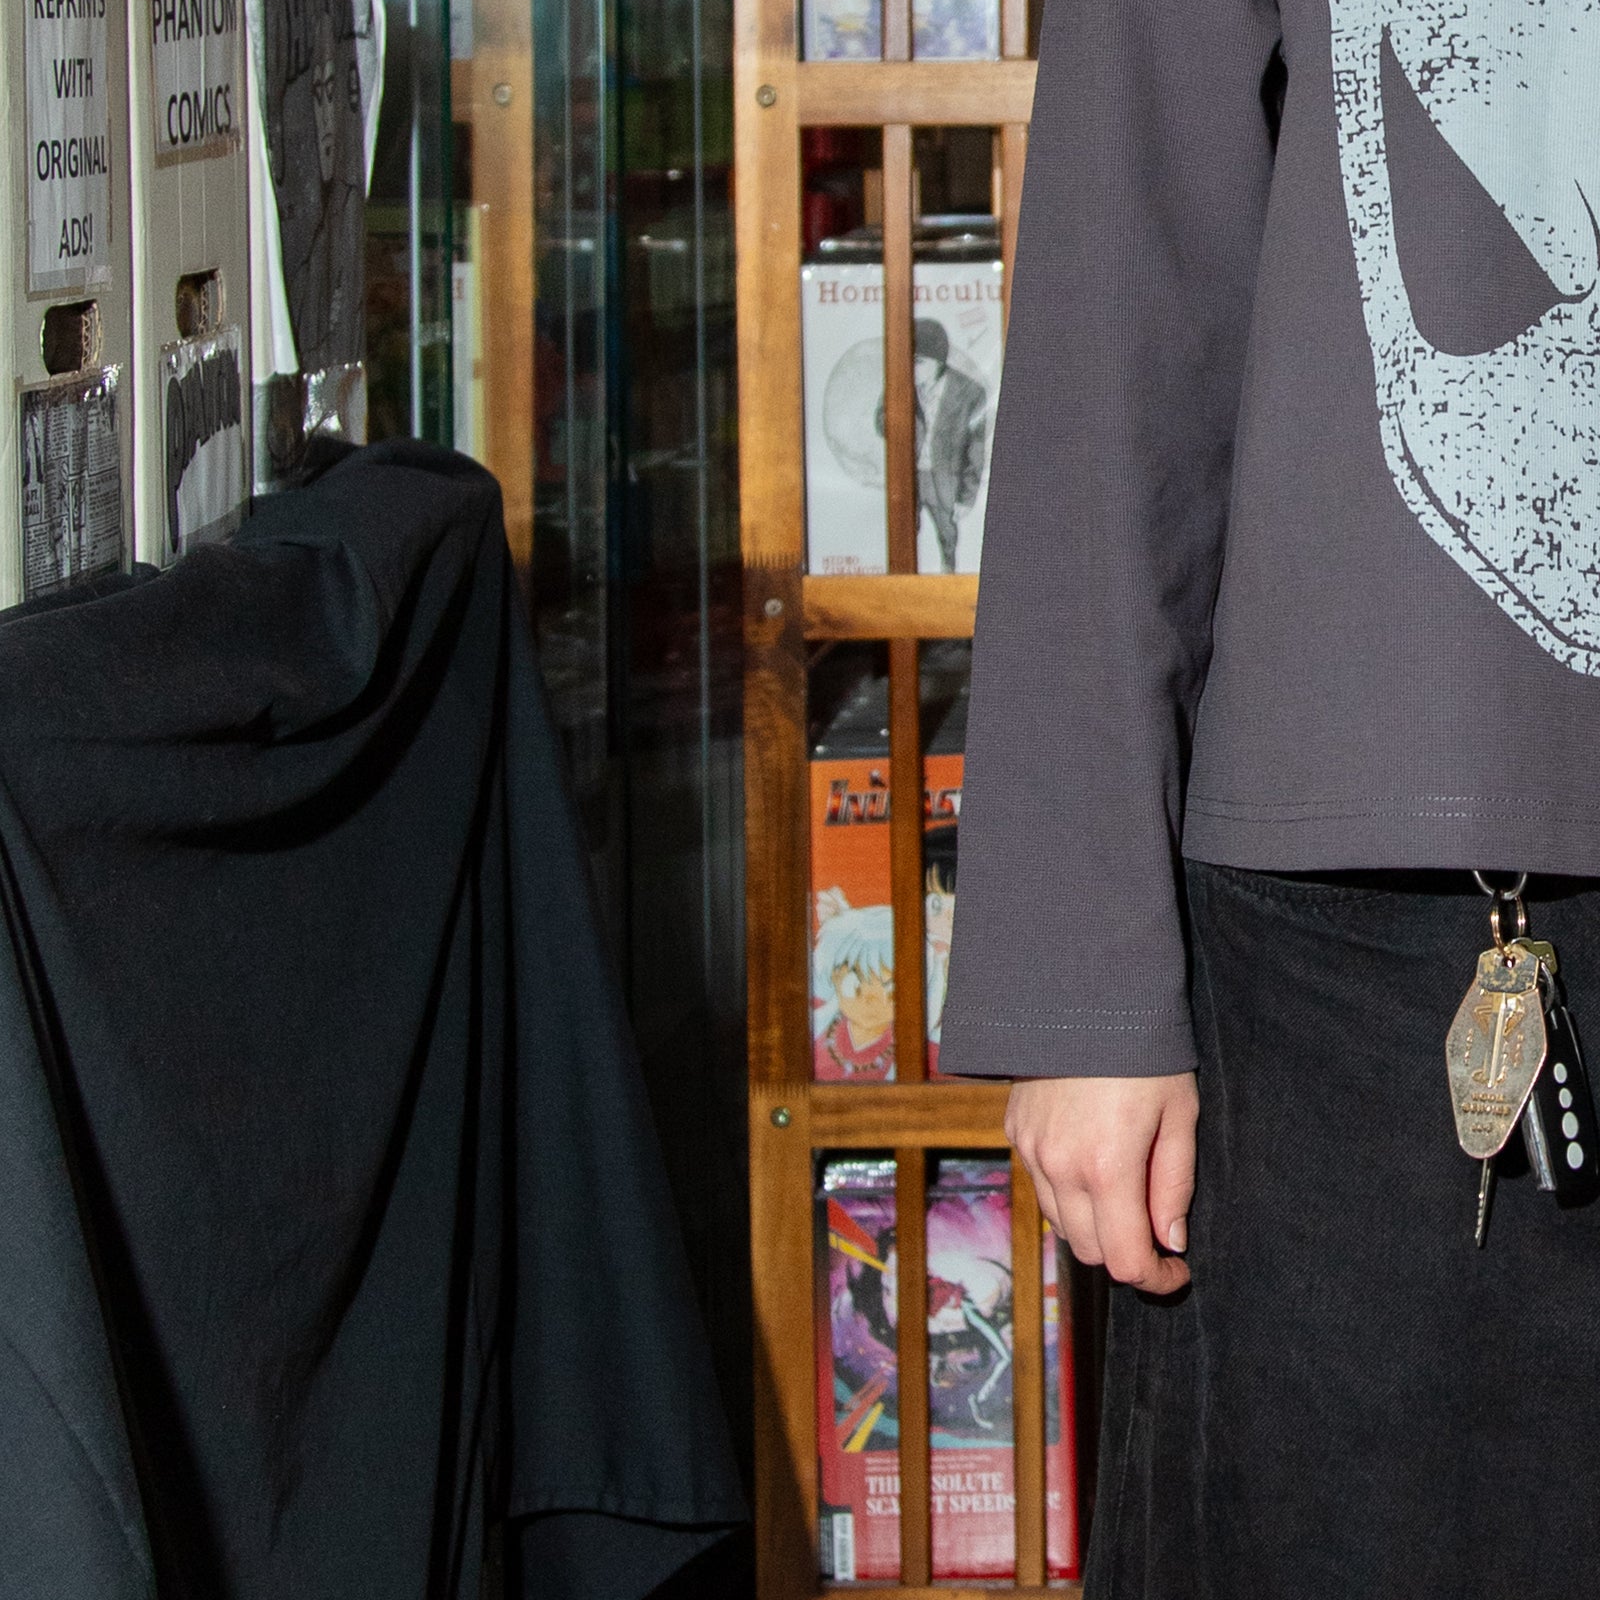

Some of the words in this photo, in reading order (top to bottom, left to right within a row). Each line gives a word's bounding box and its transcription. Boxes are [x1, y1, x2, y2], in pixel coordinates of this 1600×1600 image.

[53, 58, 93, 100] WITH
[167, 83, 232, 147] COMICS
[36, 135, 108, 182] ORIGINAL
[58, 215, 94, 259] ADS!
[818, 281, 1002, 304] Homnculu
